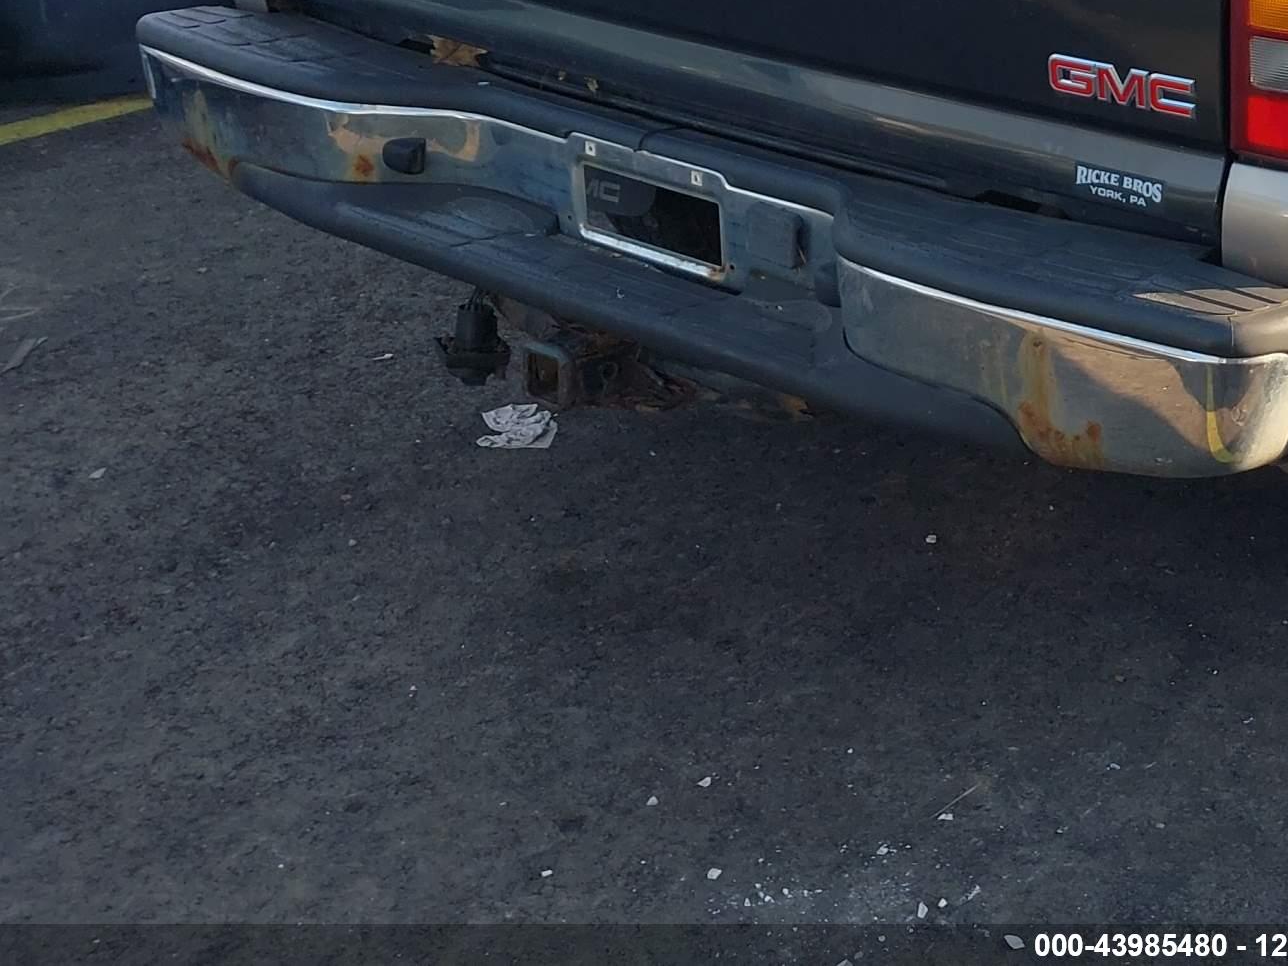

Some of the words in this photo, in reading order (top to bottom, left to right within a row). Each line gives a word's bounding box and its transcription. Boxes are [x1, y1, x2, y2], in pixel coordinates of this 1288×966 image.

[1048, 52, 1197, 119] GMC
[1076, 165, 1120, 187] RICKE
[1122, 175, 1163, 203] BROS
[1089, 185, 1127, 203] YORK,
[1129, 195, 1147, 207] PA
